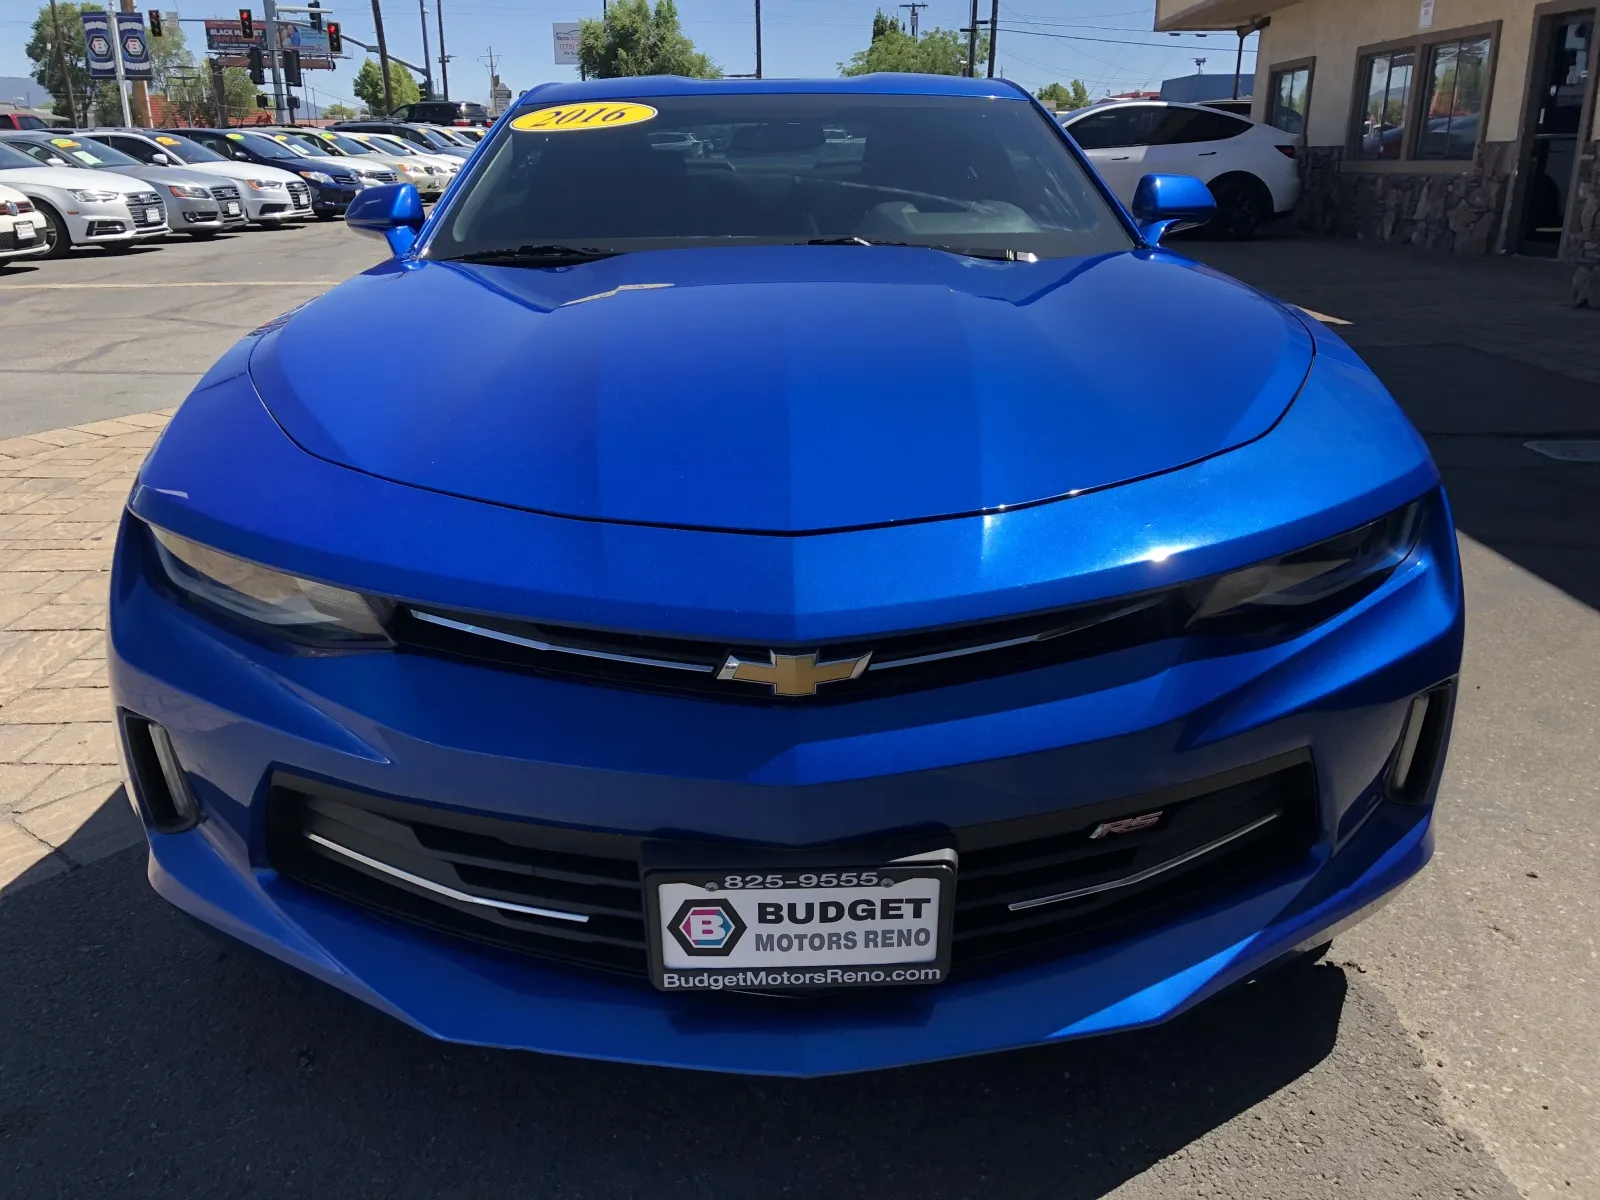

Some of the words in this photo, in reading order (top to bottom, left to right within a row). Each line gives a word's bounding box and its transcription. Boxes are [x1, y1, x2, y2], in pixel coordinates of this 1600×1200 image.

[527, 107, 636, 128] 2016
[1088, 811, 1164, 839] RS
[723, 872, 879, 889] 825-9555
[757, 898, 932, 925] BUDGET
[754, 931, 858, 952] MOTORS
[863, 927, 931, 949] RENO
[663, 967, 941, 989] BudgetMotorsReno.com
